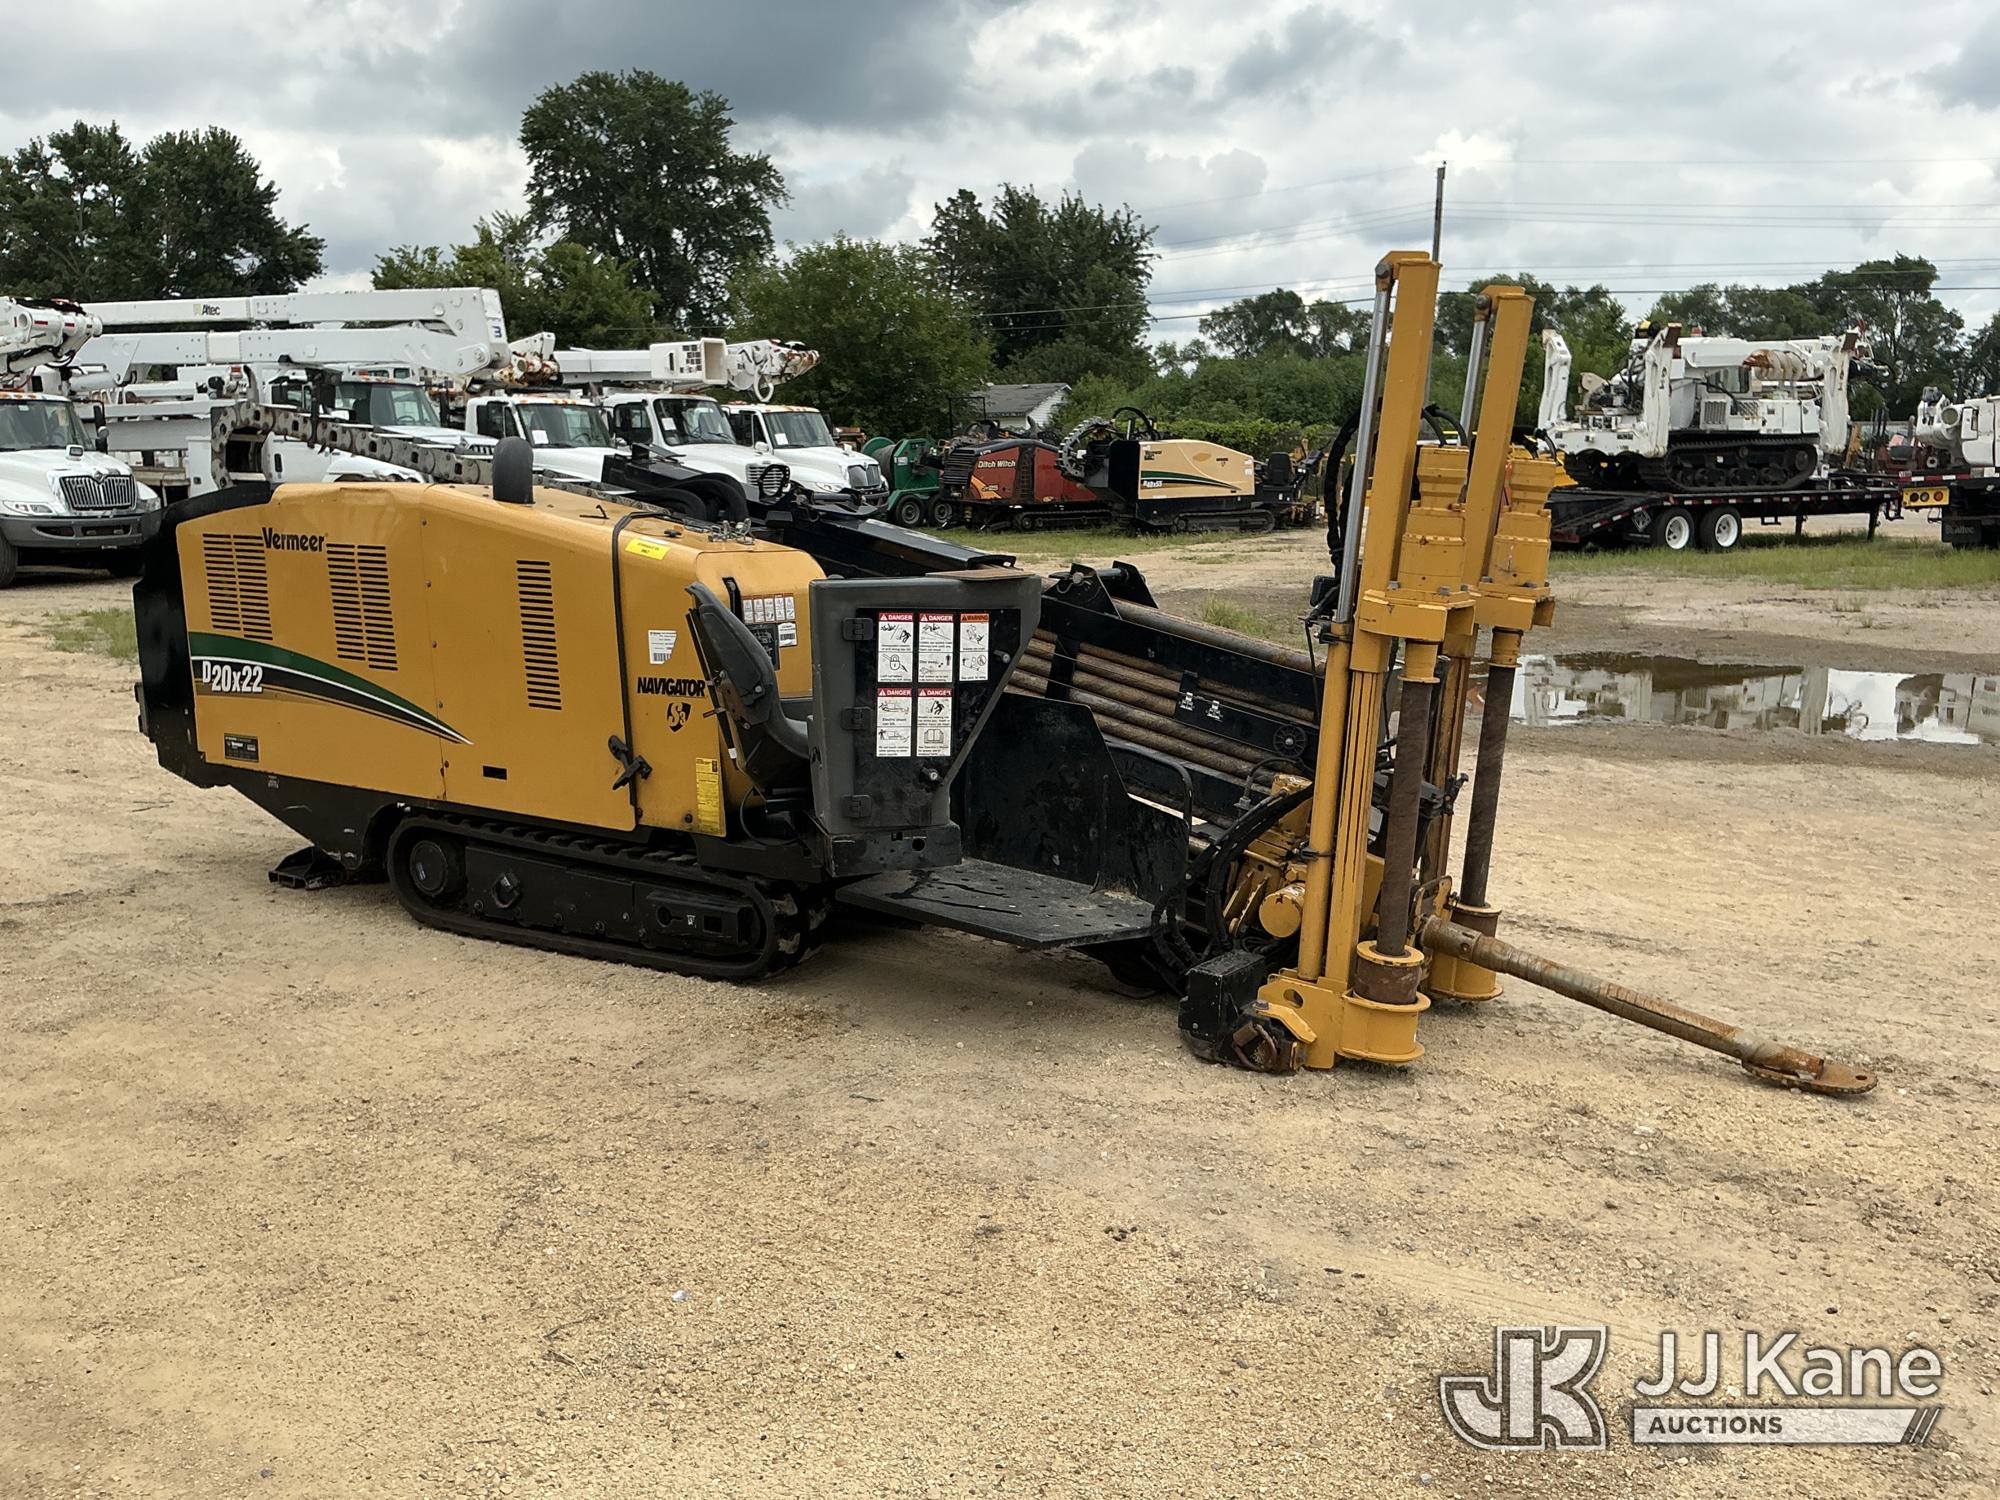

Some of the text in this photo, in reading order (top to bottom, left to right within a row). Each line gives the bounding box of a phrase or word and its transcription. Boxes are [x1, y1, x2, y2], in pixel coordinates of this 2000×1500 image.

[997, 460, 1016, 468] Witch
[262, 527, 325, 552] Vermeer
[202, 660, 263, 693] D20x22
[637, 677, 706, 697] NAVIGATOR
